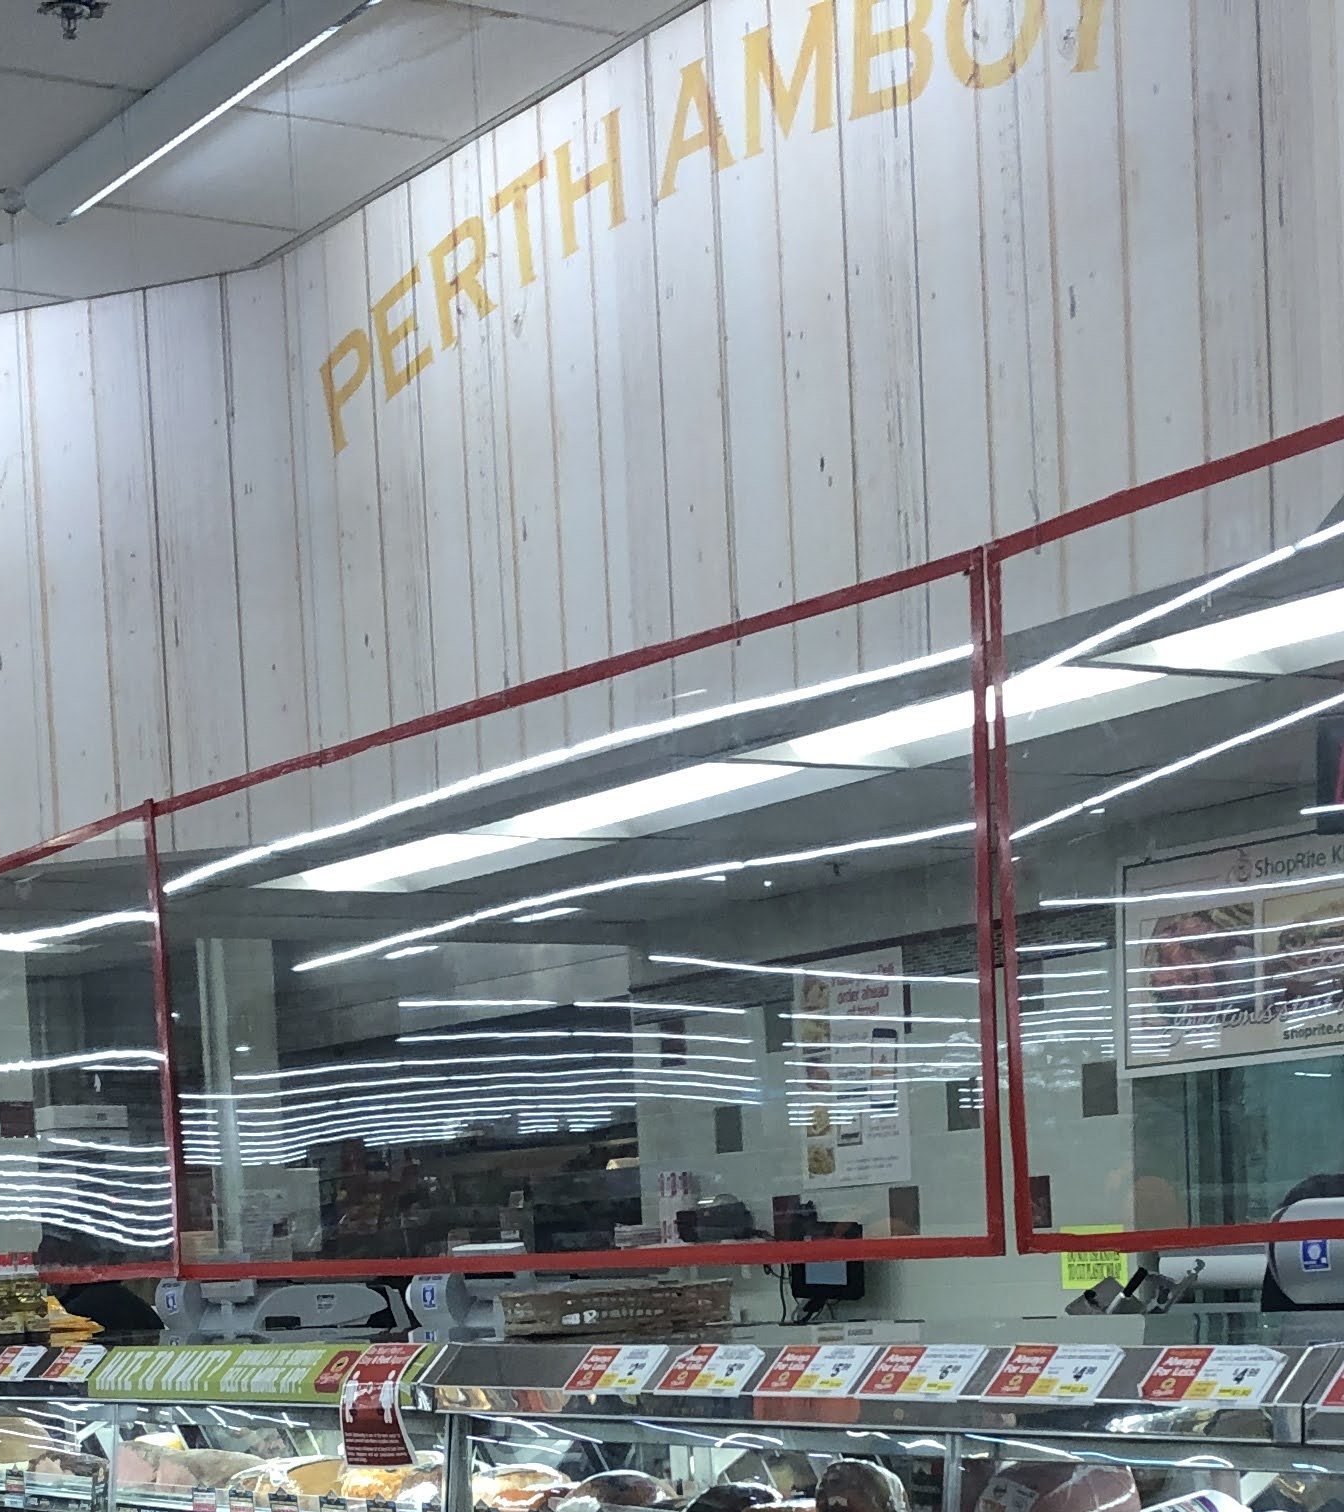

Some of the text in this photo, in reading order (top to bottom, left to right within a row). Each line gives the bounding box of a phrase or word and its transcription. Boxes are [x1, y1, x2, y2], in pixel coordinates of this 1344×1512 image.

[318, 107, 627, 457] PERTH
[1255, 850, 1327, 878] ShopRite
[95, 1350, 233, 1391] HATE TO WAIT?
